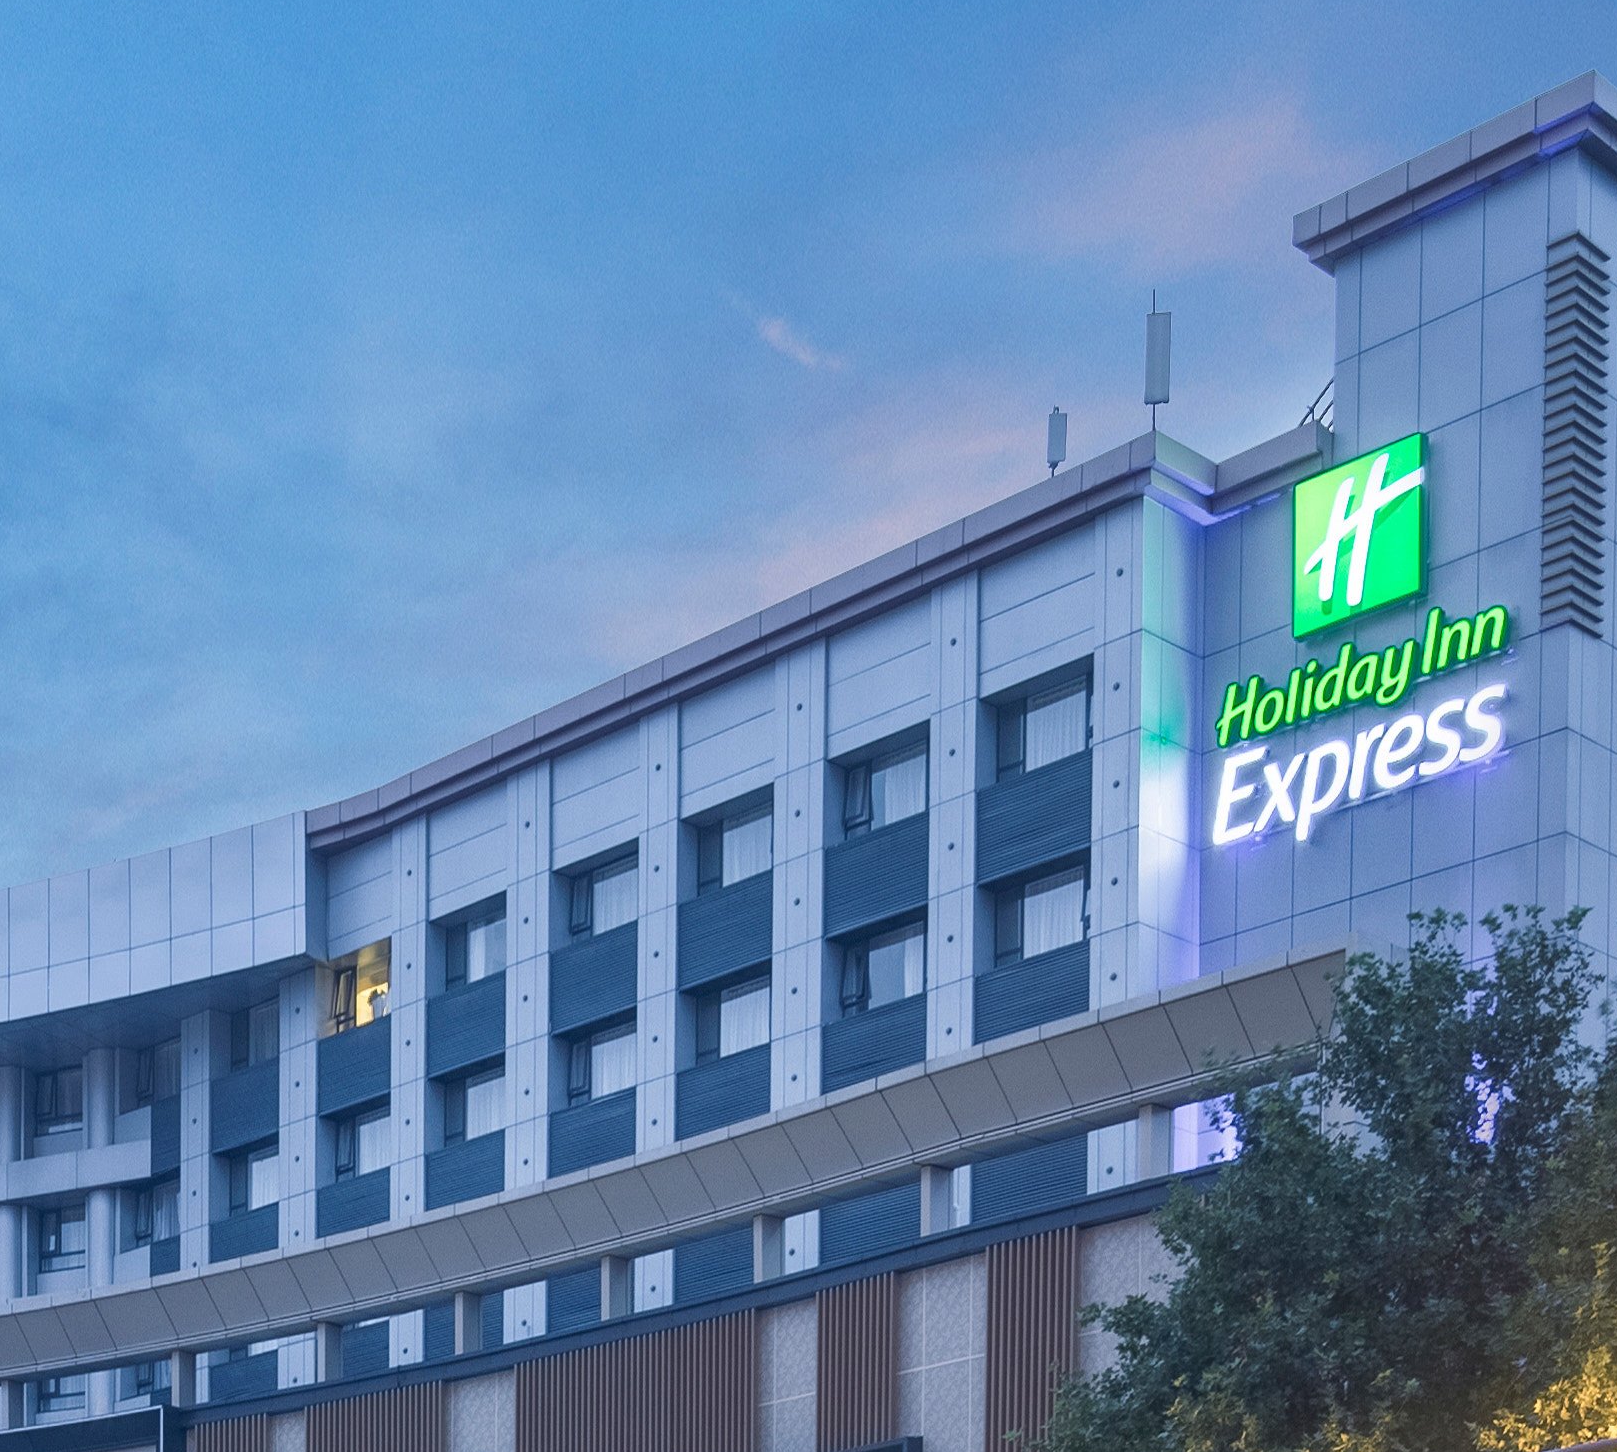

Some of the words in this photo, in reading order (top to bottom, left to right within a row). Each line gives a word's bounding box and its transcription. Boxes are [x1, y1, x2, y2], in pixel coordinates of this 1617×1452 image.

[1216, 642, 1414, 746] Holiday
[1421, 606, 1507, 674] Inn
[1212, 683, 1507, 847] Express
